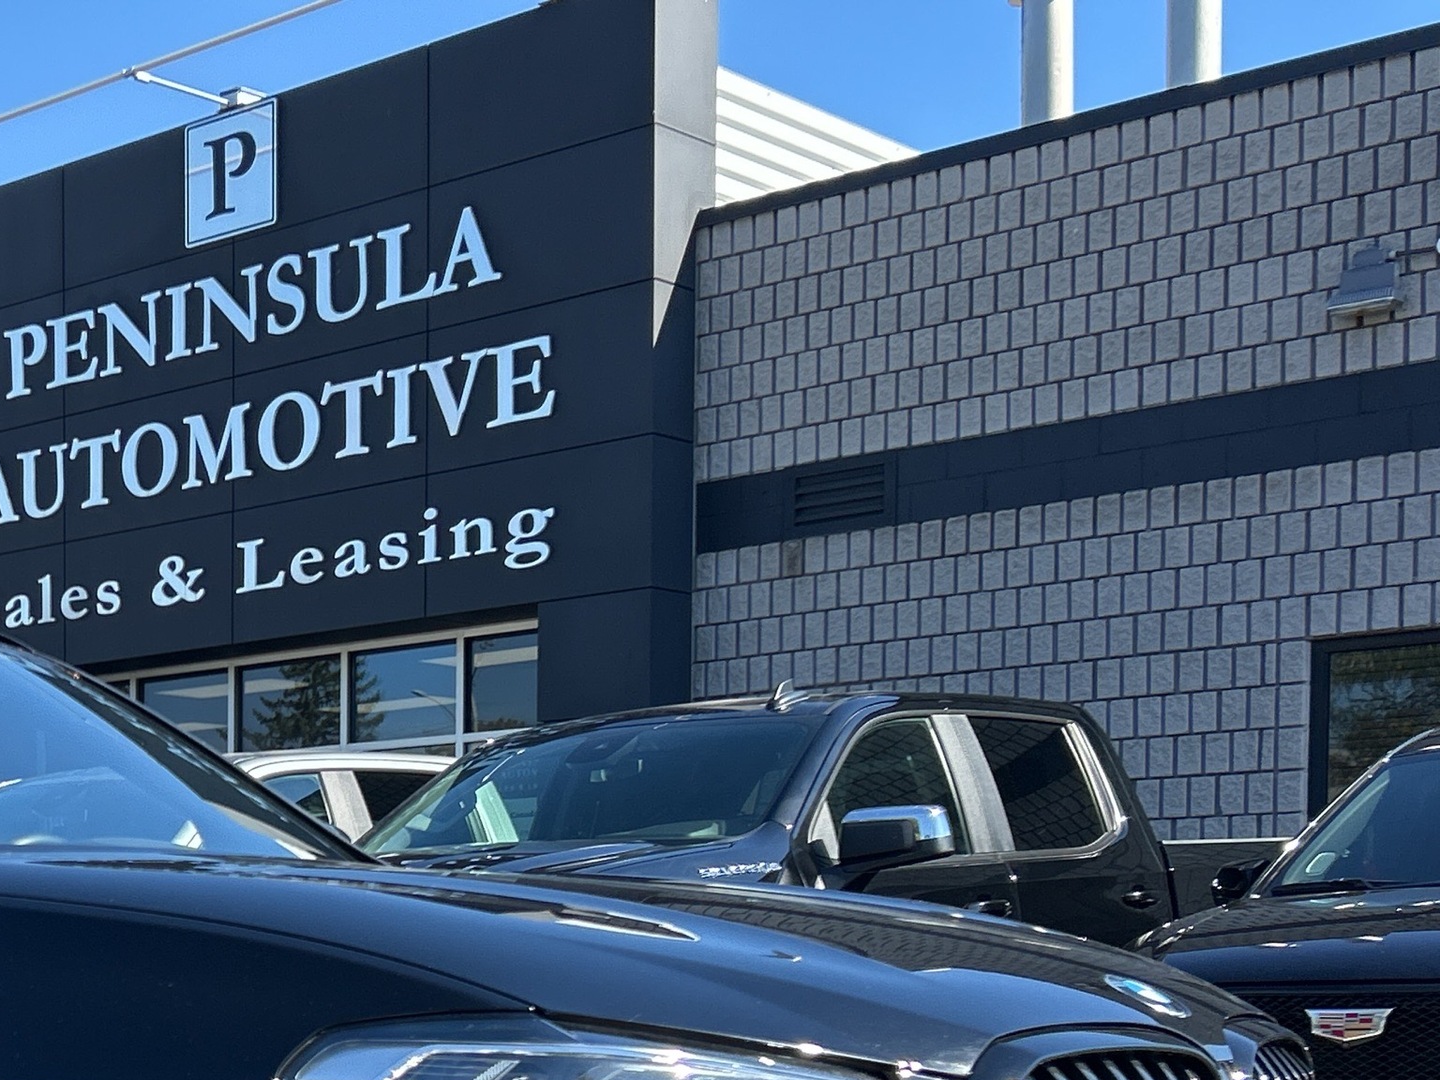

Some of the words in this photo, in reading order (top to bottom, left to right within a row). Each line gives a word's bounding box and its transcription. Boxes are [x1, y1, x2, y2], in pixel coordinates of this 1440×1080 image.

[203, 130, 258, 221] P
[3, 205, 502, 400] PENINSULA
[151, 554, 206, 608] &
[235, 505, 555, 596] Leasing
